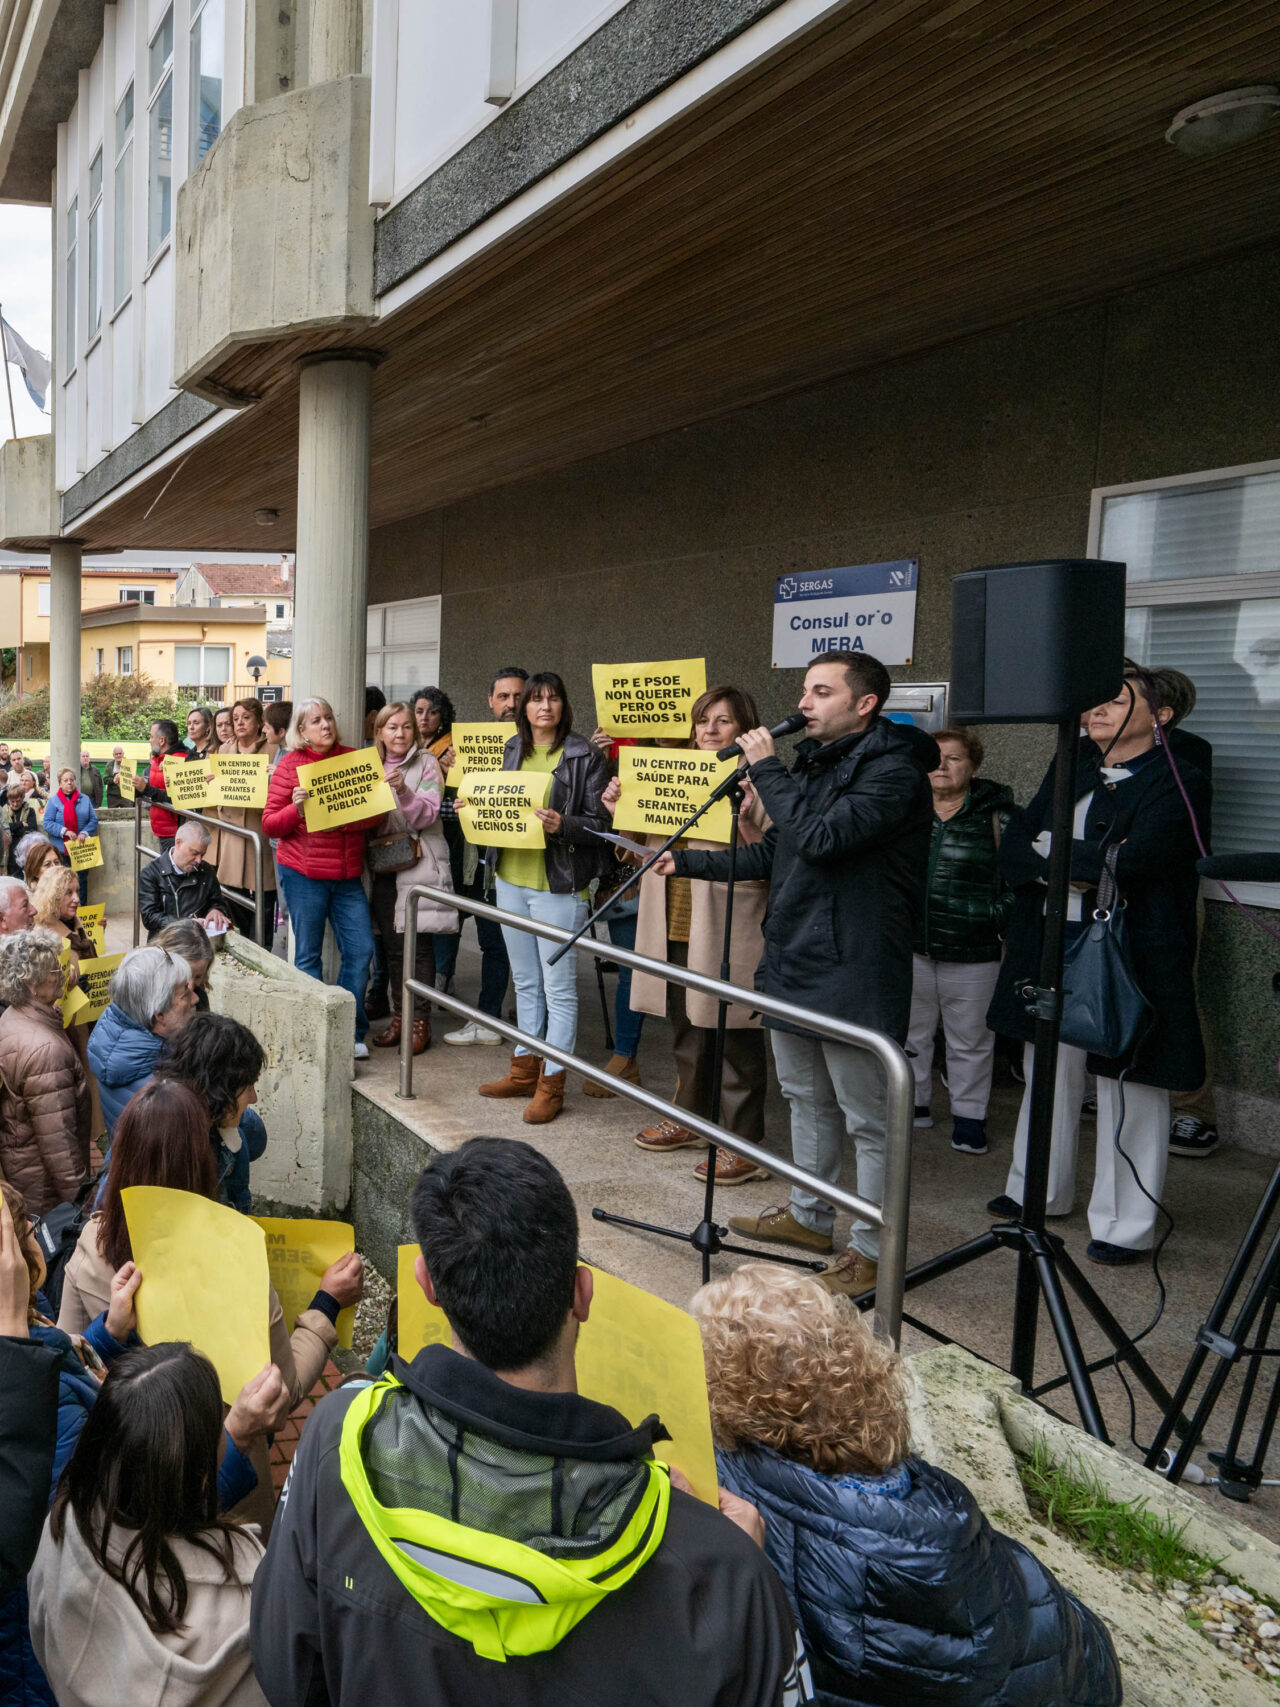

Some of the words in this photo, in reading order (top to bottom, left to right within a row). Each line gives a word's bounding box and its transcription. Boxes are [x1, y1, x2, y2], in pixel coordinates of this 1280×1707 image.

[800, 579, 833, 592] SERGAS
[812, 636, 864, 652] MERA
[612, 679, 628, 688] PP
[632, 678, 640, 687] E
[644, 676, 680, 686] PSOE
[605, 690, 631, 700] NON
[636, 688, 691, 701] QUEREN
[620, 702, 654, 711] PERO
[658, 701, 677, 710] OS
[612, 712, 670, 724] VECIÑOS
[673, 713, 686, 722] SI
[463, 736, 473, 744] PP
[482, 736, 504, 744] PSOE
[459, 746, 476, 754] NON
[478, 746, 504, 754] QUERE
[468, 757, 489, 765] PERO
[491, 757, 502, 765] OS
[632, 758, 647, 768] UN
[650, 760, 696, 771] CENTRO
[700, 762, 717, 772] DE
[311, 763, 372, 786] DEFENDAMOS
[636, 770, 674, 784] SAÚDE
[678, 775, 709, 786] PARA
[316, 772, 379, 796] MELLOREMOS
[473, 786, 486, 794] PP
[488, 786, 495, 794] E
[497, 785, 525, 794] PSOE
[326, 784, 373, 803] SANIDADE
[655, 787, 689, 801] DEXO,
[328, 796, 367, 813] PÚBLICA
[467, 797, 485, 806] NON
[488, 797, 531, 808] QUEREN
[638, 799, 697, 813] SERANTES
[478, 809, 502, 819] PERO
[506, 810, 520, 819] OS
[472, 819, 514, 832] VECIÑOS
[516, 823, 526, 832] SI
